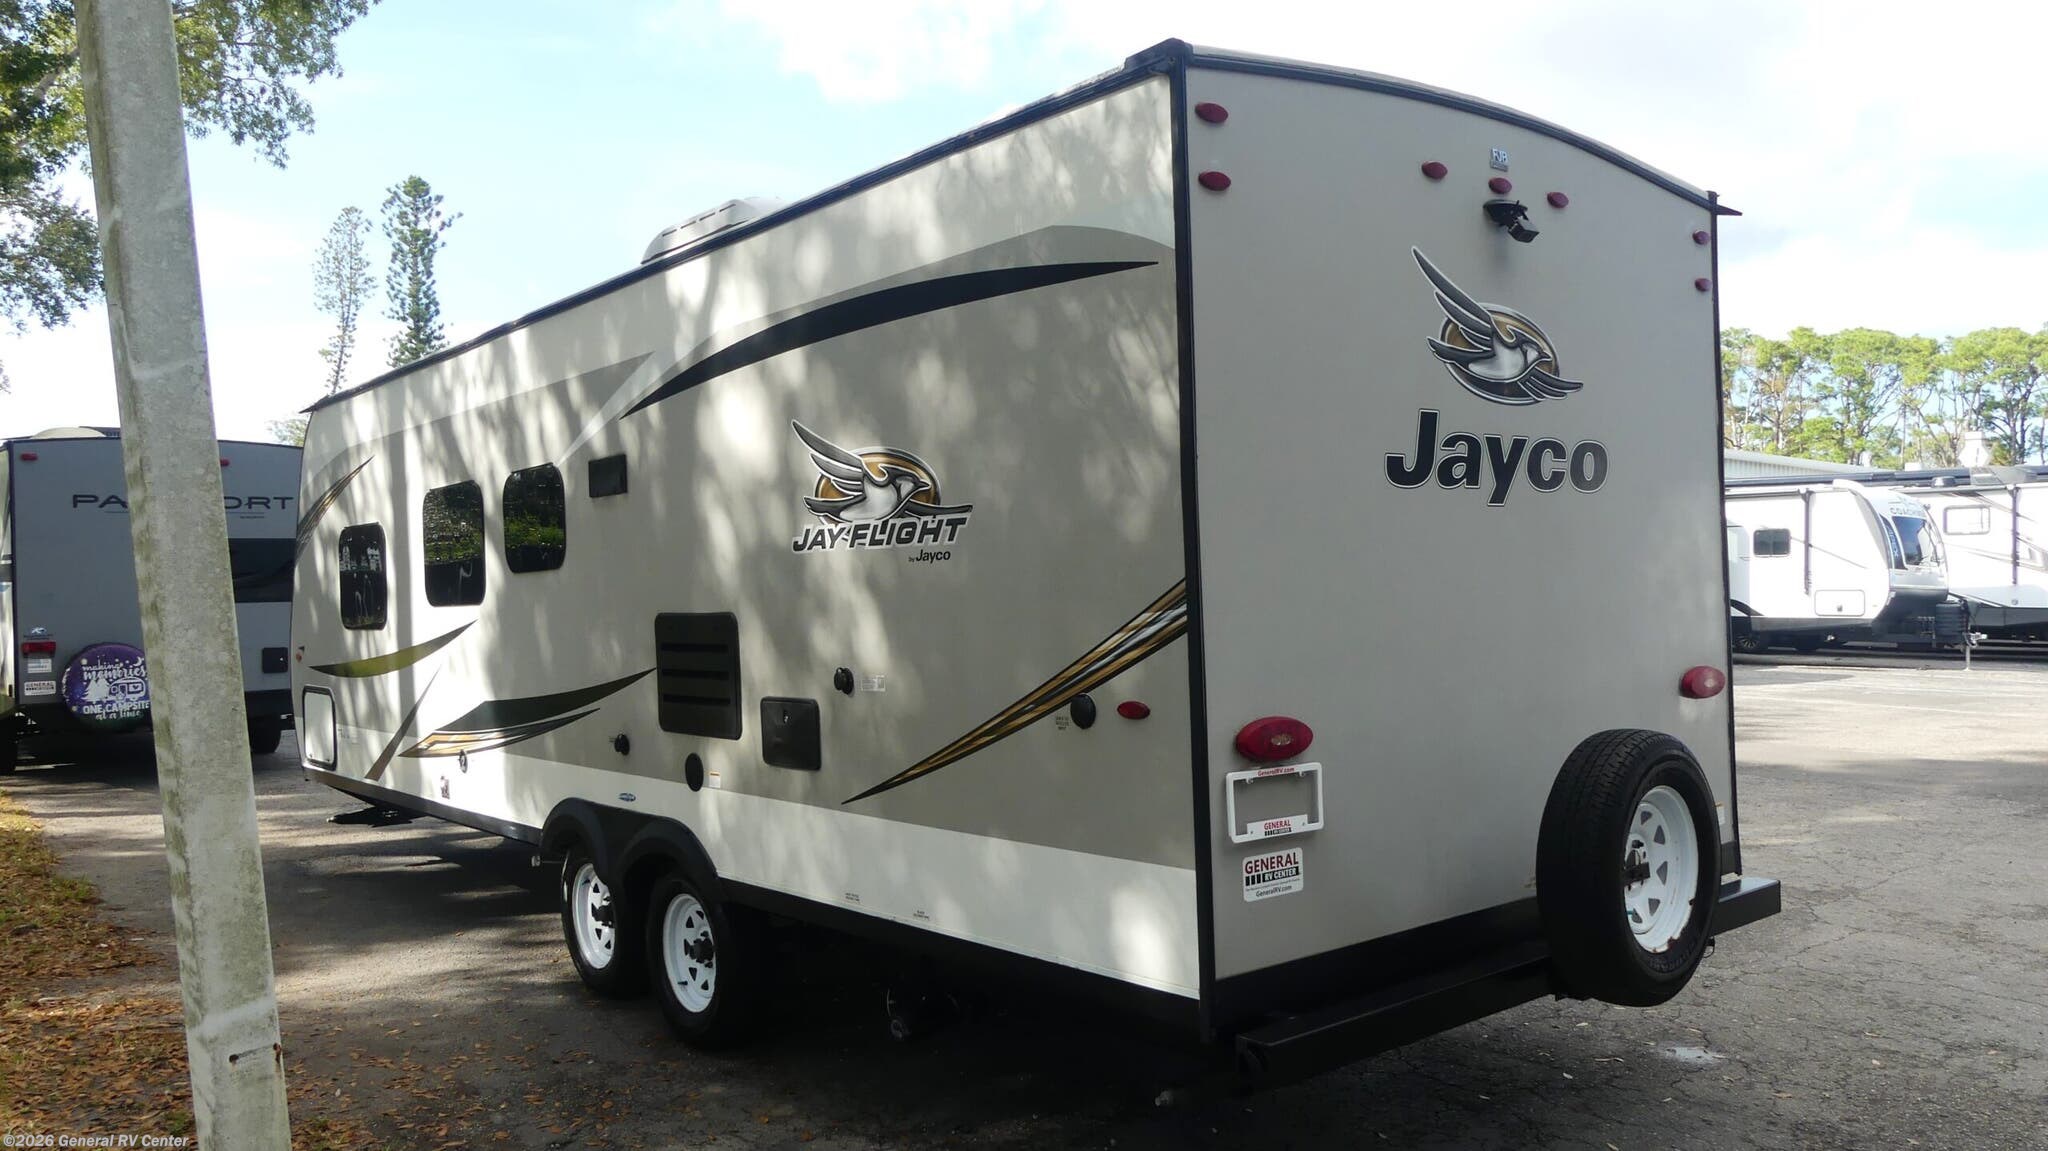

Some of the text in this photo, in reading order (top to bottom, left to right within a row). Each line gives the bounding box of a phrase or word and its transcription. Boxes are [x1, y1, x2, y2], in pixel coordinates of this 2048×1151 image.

[1385, 408, 1608, 507] Jayco
[73, 494, 294, 509] PAORT
[793, 516, 968, 552] JAY FLIGHT
[916, 549, 951, 564] Jayco
[83, 666, 146, 680] memories
[83, 701, 150, 715] ONE CAMPSITE
[1264, 819, 1292, 831] GENERAL
[1245, 852, 1299, 875] GENERAL
[1264, 868, 1297, 881] RV CENTER
[1256, 885, 1293, 898] GeneralRV.com
